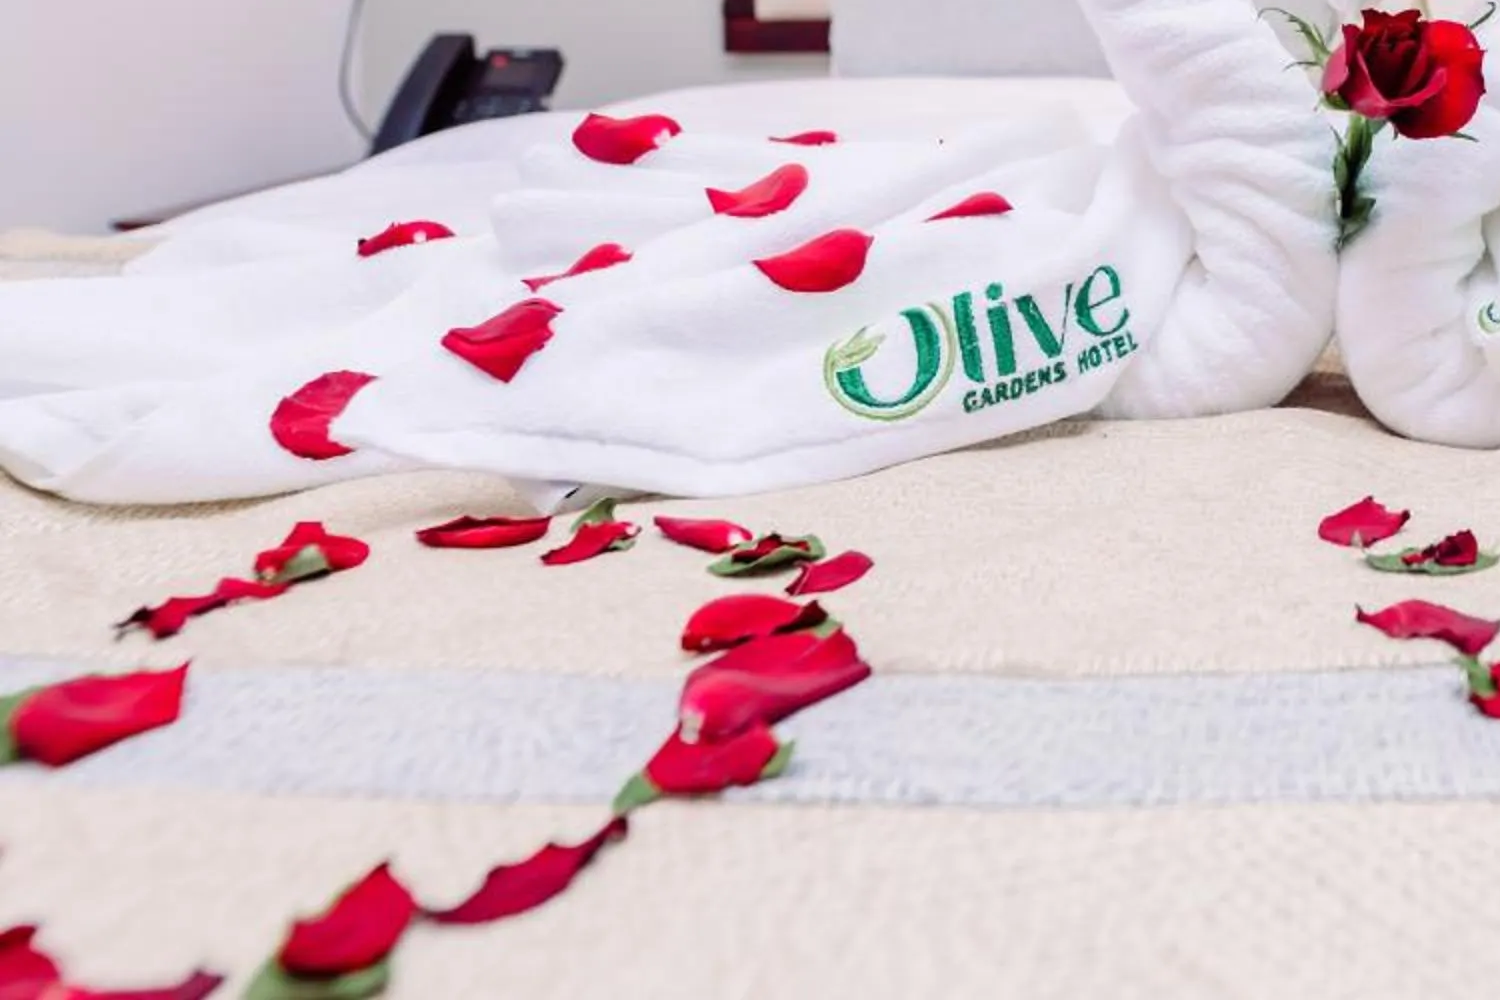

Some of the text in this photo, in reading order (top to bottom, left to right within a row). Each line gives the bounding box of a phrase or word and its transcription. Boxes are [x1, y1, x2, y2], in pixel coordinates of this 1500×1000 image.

[823, 265, 1130, 421] Olive
[963, 331, 1139, 414] GARDENS HOTEL
